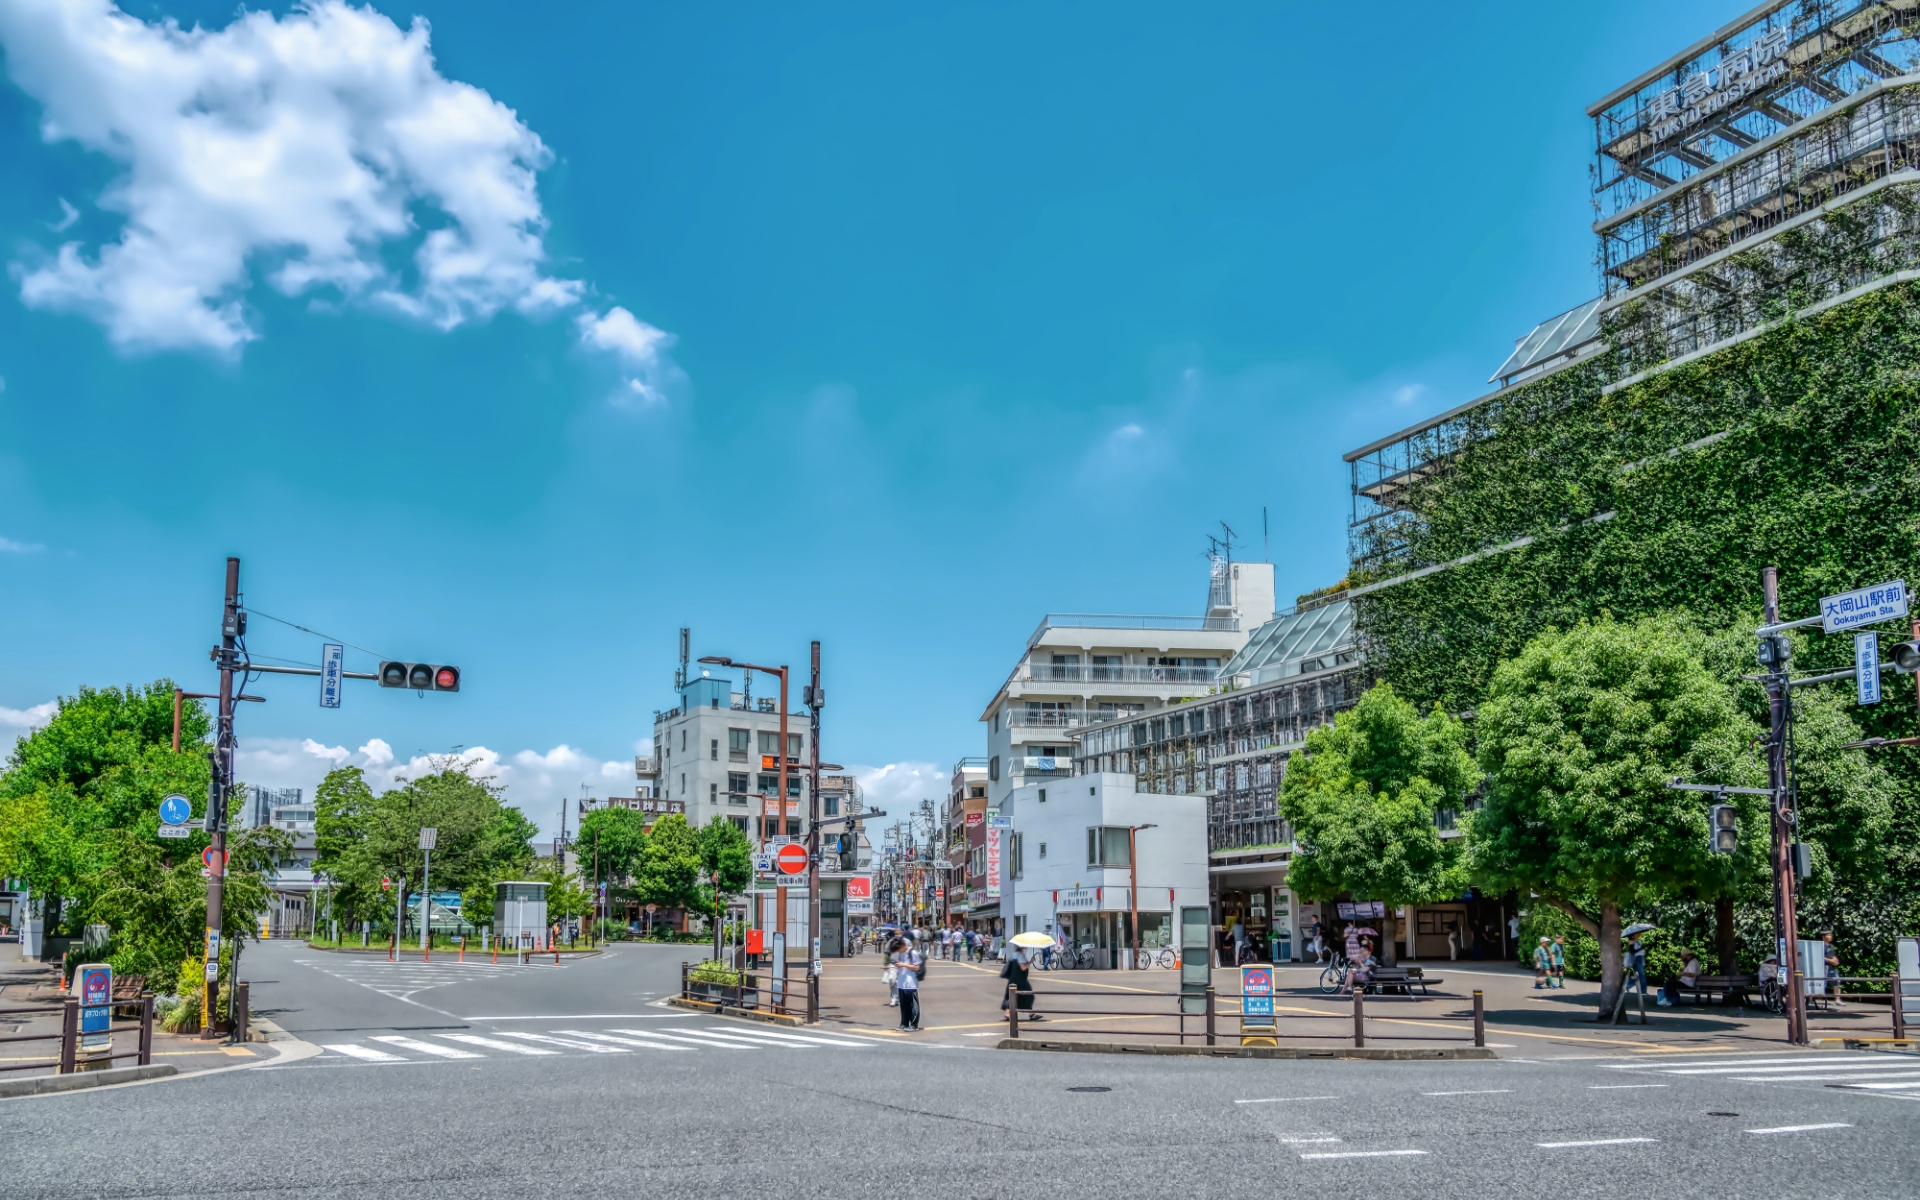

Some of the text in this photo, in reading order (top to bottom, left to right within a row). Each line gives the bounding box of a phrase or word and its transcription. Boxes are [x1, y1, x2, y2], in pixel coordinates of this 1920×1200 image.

[1649, 25, 1788, 127] 東急病院
[1649, 59, 1790, 143] TOKYU HOSPITAL
[1825, 586, 1901, 618] 大岡山駅前
[1833, 606, 1896, 626] Ookayama Sta.
[988, 828, 1000, 887] マツヤデンキ
[778, 877, 807, 885] 自転車を除く
